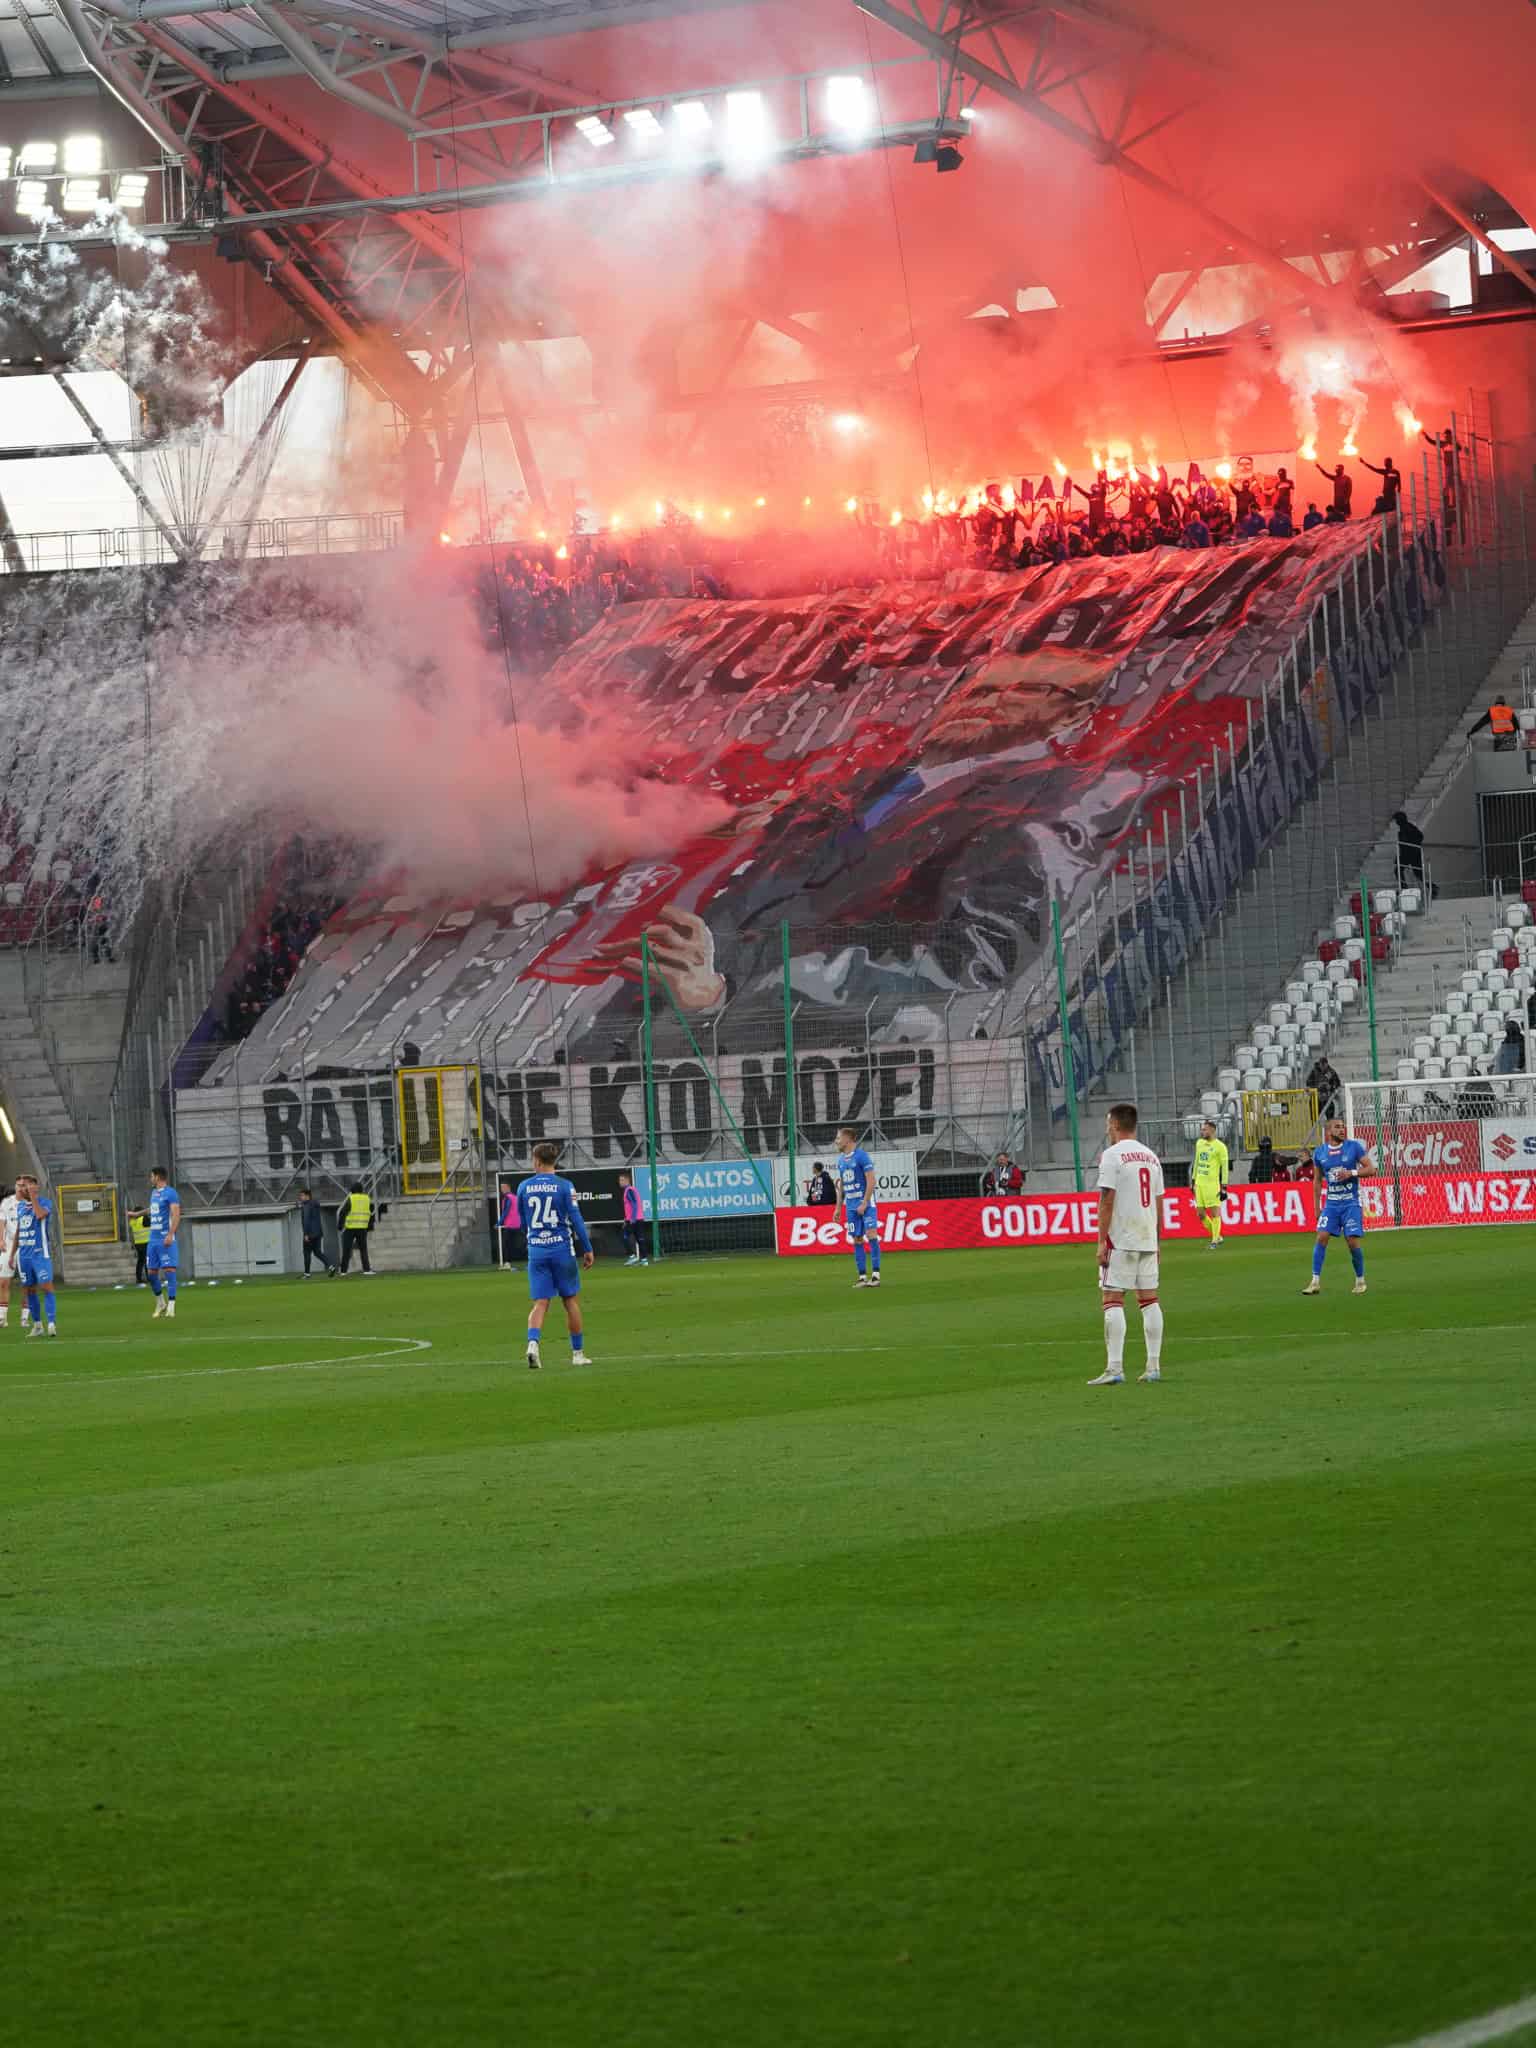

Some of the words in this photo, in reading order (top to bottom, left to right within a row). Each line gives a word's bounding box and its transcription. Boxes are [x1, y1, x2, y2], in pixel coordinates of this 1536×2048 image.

[590, 1062, 712, 1158] KTO
[678, 1169, 754, 1190] SALTOS
[528, 1196, 559, 1229] 24
[642, 1198, 680, 1212] PRK
[682, 1193, 768, 1209] TRAMPOLIN
[790, 1210, 930, 1247] Belic
[981, 1197, 1182, 1239] CODZIEE
[1444, 1178, 1536, 1214] WSZ
